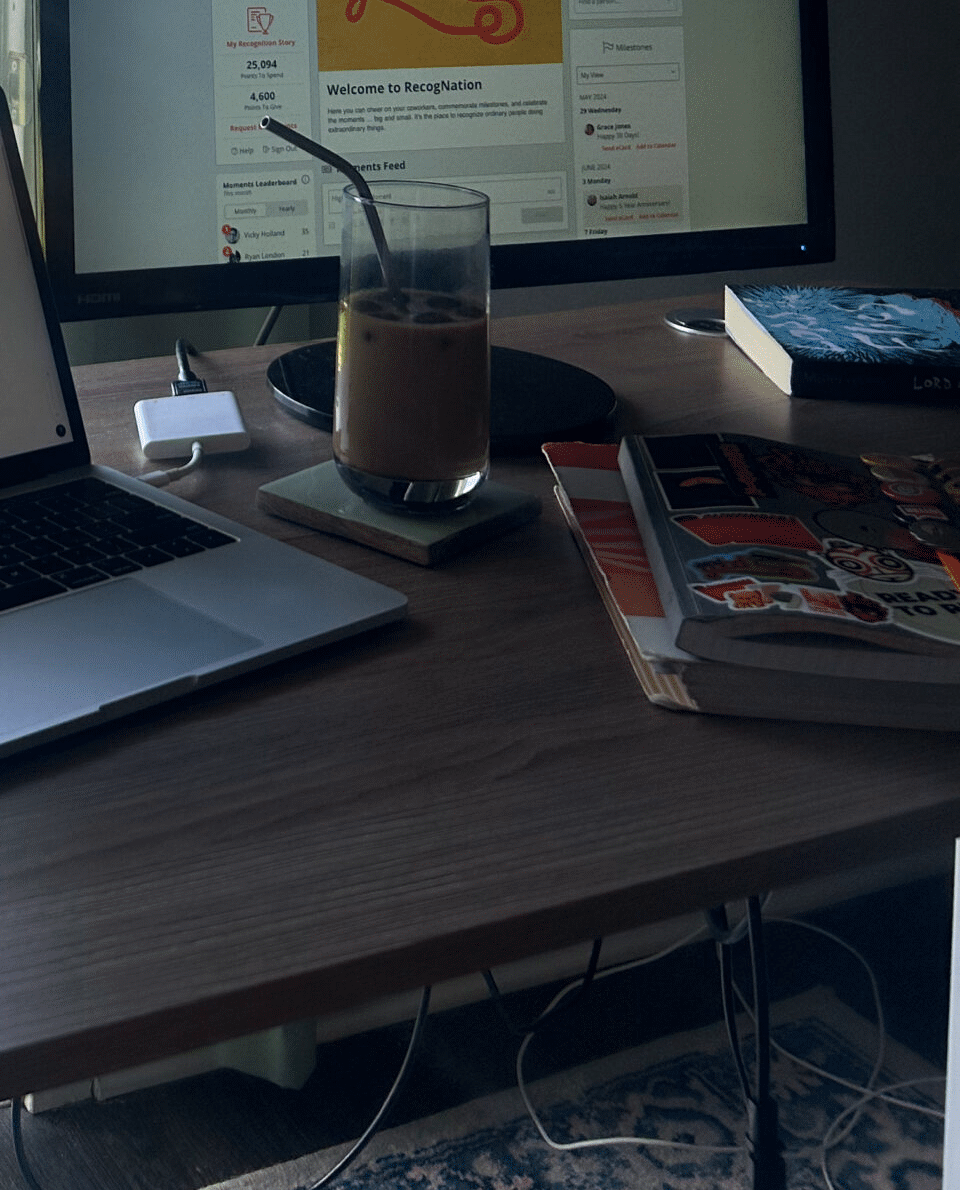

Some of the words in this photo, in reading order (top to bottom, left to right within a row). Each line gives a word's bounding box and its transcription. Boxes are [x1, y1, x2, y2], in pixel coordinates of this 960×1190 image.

[238, 40, 277, 48] Recognition
[616, 43, 653, 52] Milestones
[246, 60, 277, 71] 25,094
[266, 72, 284, 80] Spend
[581, 72, 590, 80] My
[327, 83, 385, 97] Welcome
[388, 82, 401, 95] to
[404, 79, 483, 95] RecogNation
[250, 92, 276, 102] 4,600
[384, 114, 395, 122] and
[230, 124, 257, 132] Request
[328, 126, 366, 134] extraordinary
[239, 147, 254, 155] Help
[271, 146, 285, 154] Sign
[384, 160, 406, 171] Feed
[255, 179, 297, 187] Leaderboard
[618, 192, 639, 200] Arnold
[244, 231, 260, 239] Vicky
[261, 230, 286, 238] Holland
[589, 228, 608, 236] Friday
[244, 254, 260, 262] Ryan
[875, 589, 960, 604] READ
[893, 604, 938, 616] TO
